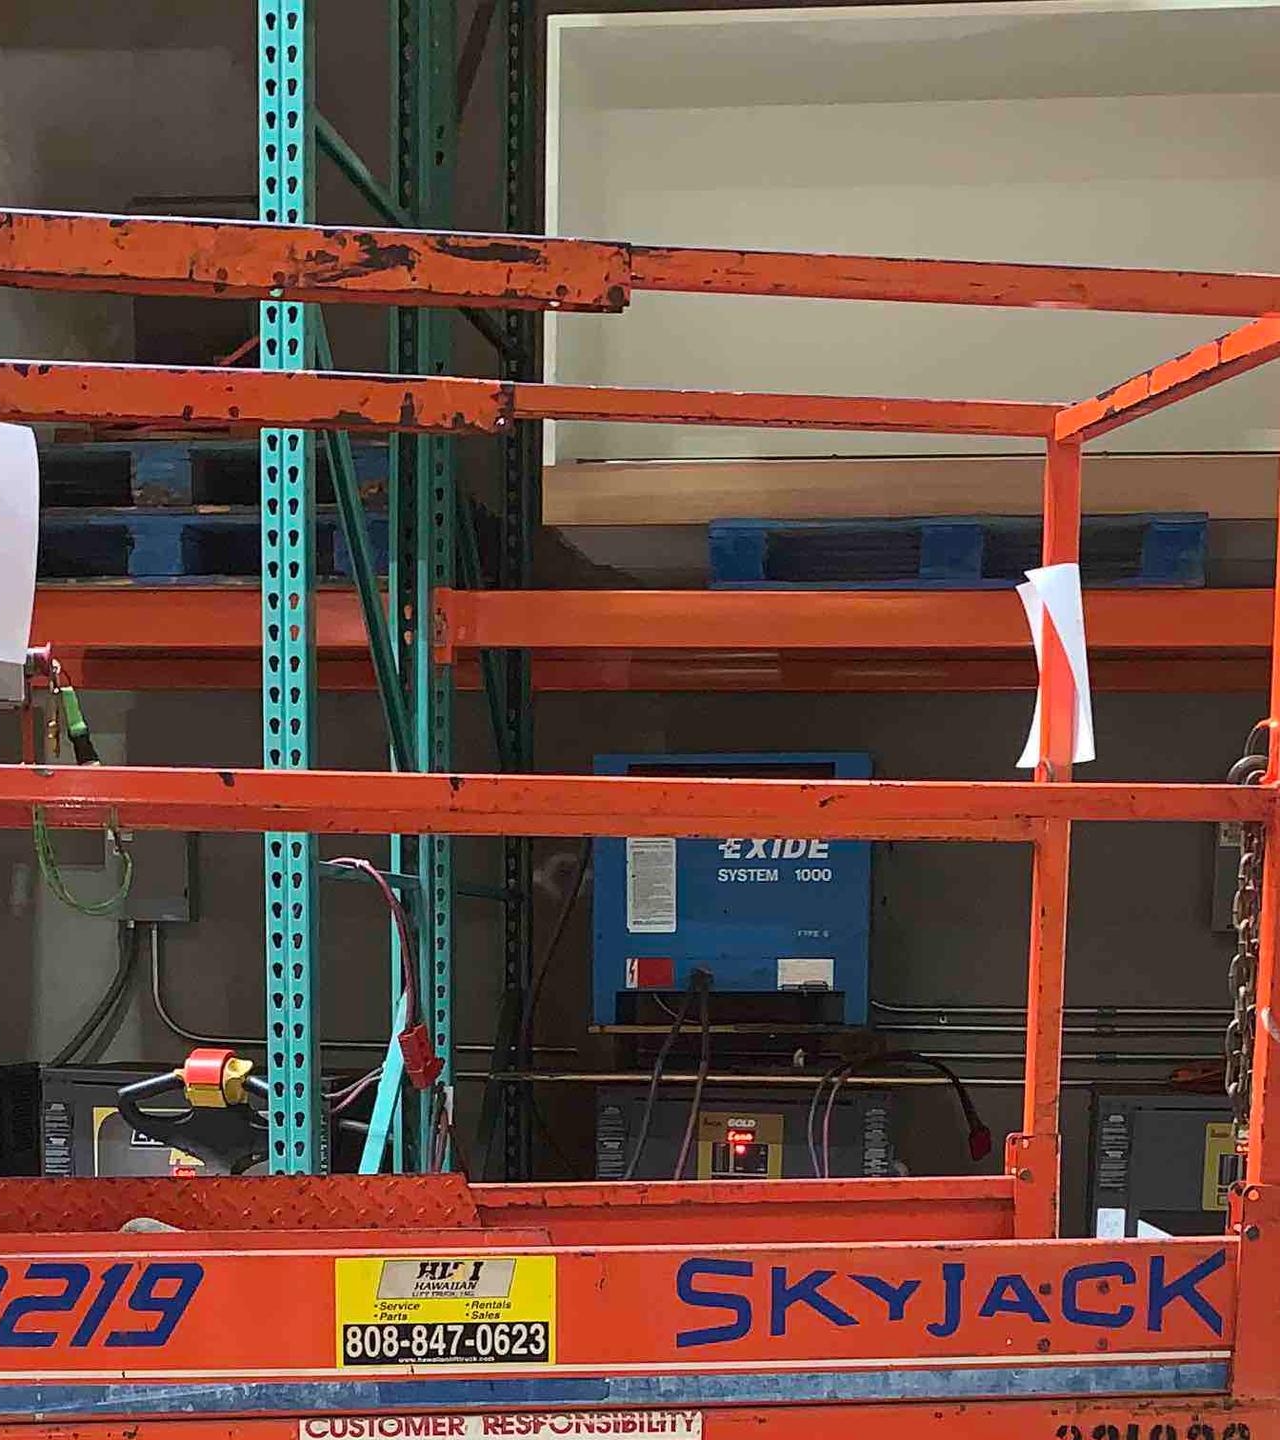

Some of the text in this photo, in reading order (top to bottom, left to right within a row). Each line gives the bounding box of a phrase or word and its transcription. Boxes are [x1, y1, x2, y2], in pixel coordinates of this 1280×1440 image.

[718, 838, 829, 860] EXIDE
[718, 868, 832, 882] SYSTEM 1000
[414, 1281, 478, 1291] HAWAIIAN
[676, 1248, 1227, 1348] SKYJACK
[379, 1302, 421, 1311] Service
[471, 1301, 512, 1310] Rentals
[379, 1312, 408, 1321] Parts
[471, 1310, 500, 1320] Sales
[346, 1323, 546, 1358] 808-847-0623
[305, 1411, 697, 1438] CUSTOMER RESPONSIBILITY
